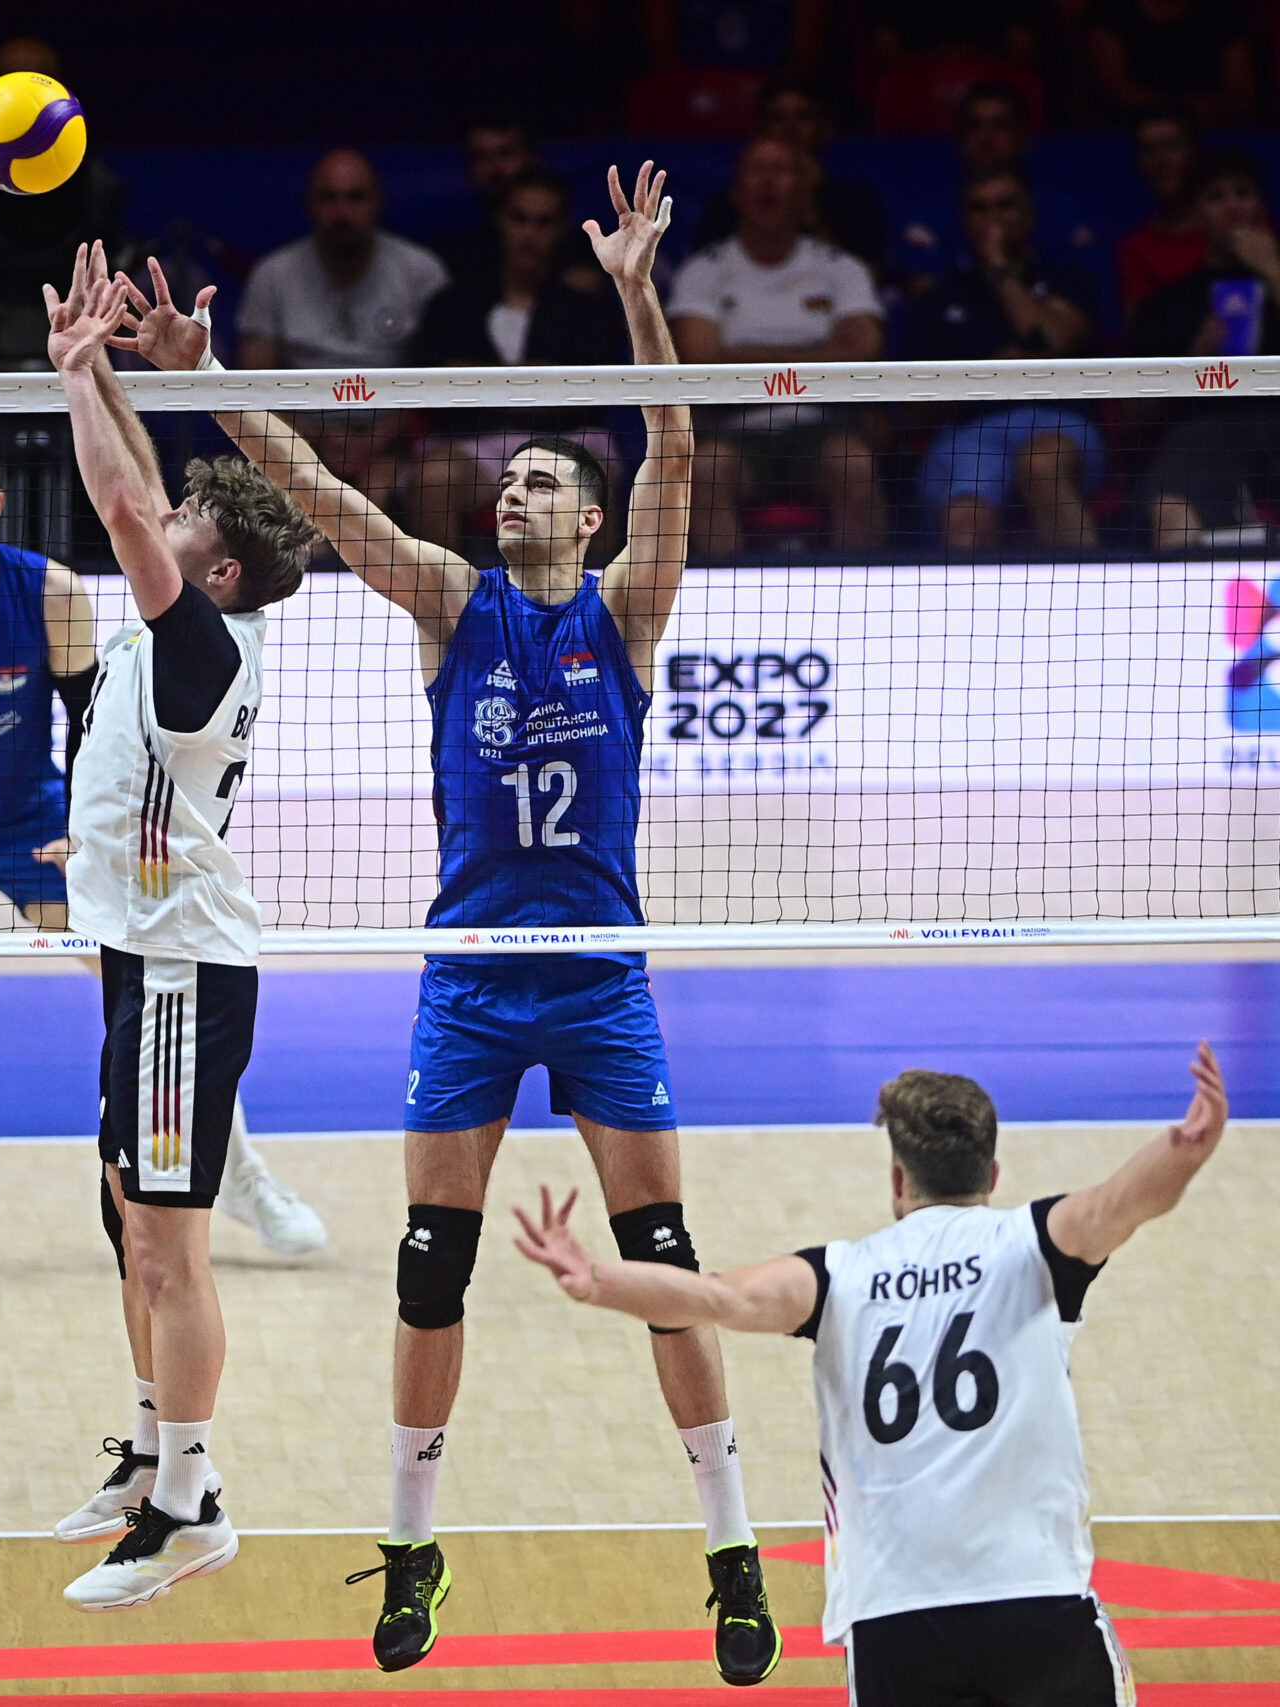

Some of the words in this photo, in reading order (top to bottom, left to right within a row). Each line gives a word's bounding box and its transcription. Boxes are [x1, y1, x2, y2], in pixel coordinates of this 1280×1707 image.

[334, 374, 376, 401] VNL
[764, 370, 806, 396] VNL
[1199, 363, 1240, 389] VNL
[486, 674, 518, 691] PEAK
[667, 653, 830, 690] EXPO
[526, 711, 600, 731] ПОШТАНСКА
[669, 702, 829, 739] 2027
[527, 724, 609, 745] ШТЕДИОНИЦА
[479, 747, 502, 759] 1921
[501, 761, 580, 847] 12
[490, 935, 587, 944] VOLLEYBALL
[921, 929, 1017, 938] VOLLEYBALL
[870, 1254, 983, 1300] RÖHRS
[863, 1310, 999, 1444] 66
